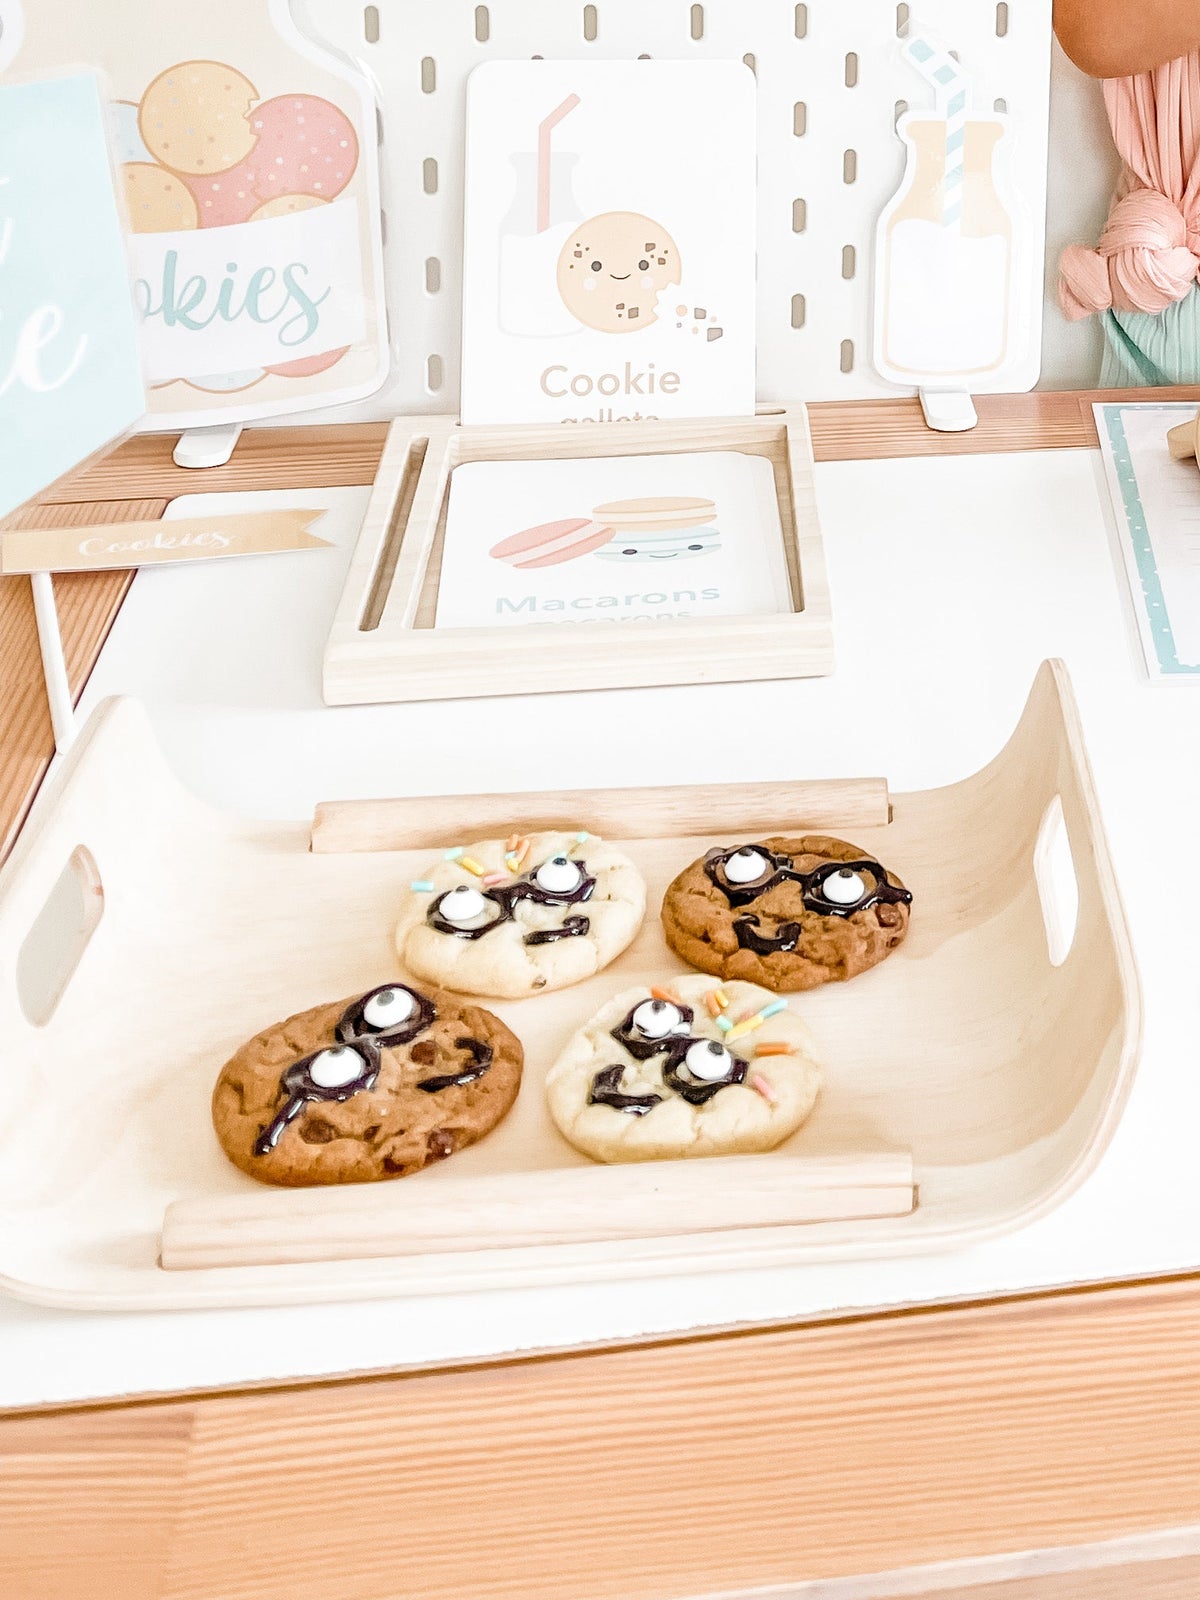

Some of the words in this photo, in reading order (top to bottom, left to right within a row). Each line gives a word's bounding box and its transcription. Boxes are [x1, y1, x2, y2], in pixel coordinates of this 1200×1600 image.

[539, 361, 682, 399] Cookie
[78, 532, 237, 557] Cookies
[495, 587, 721, 614] Macarons
